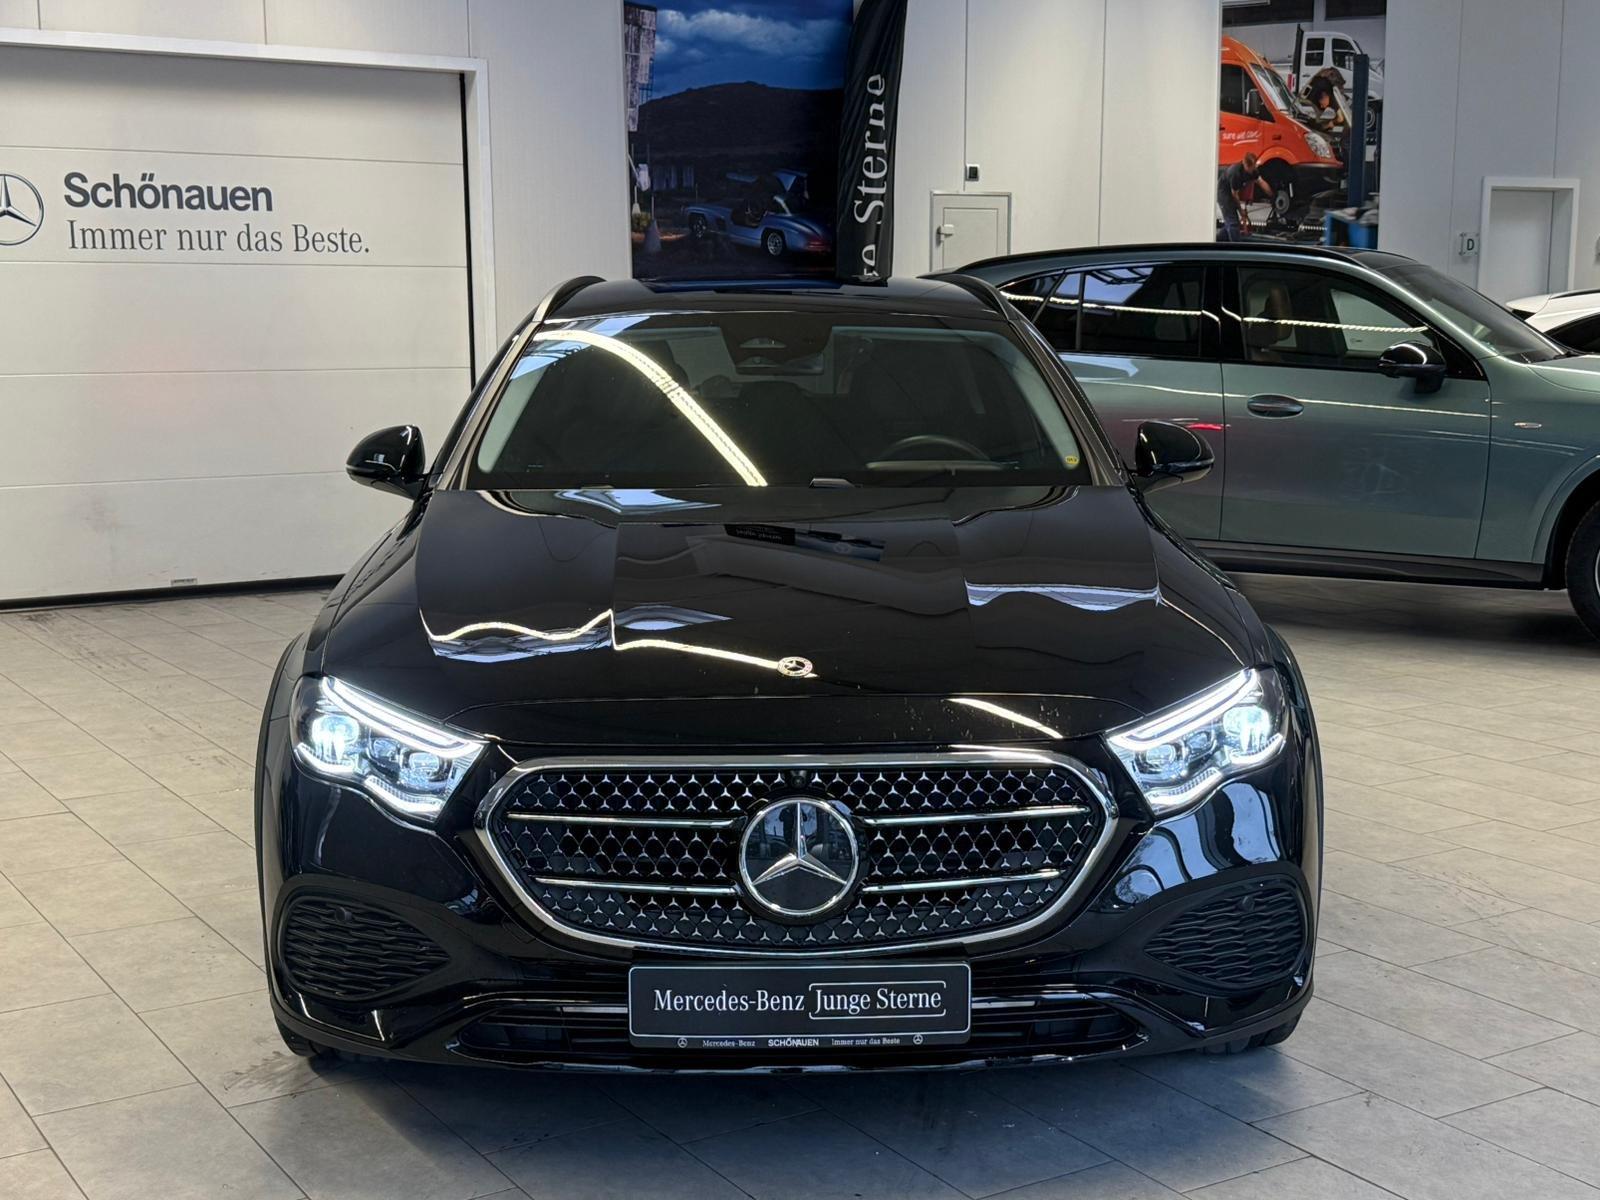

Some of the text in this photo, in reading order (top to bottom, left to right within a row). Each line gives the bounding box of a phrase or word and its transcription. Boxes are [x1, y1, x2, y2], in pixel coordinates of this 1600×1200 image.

[853, 74, 888, 225] Sterne
[63, 172, 273, 211] Schönauen
[67, 219, 370, 253] Immer nur das Beste.
[1467, 238, 1475, 250] D
[653, 988, 942, 1014] Mercedes-Benz Junge Sterne
[702, 1039, 756, 1047] Mercedes-Benz
[831, 1038, 853, 1046] Immer
[869, 1037, 881, 1045] das
[882, 1037, 900, 1045] Beste
